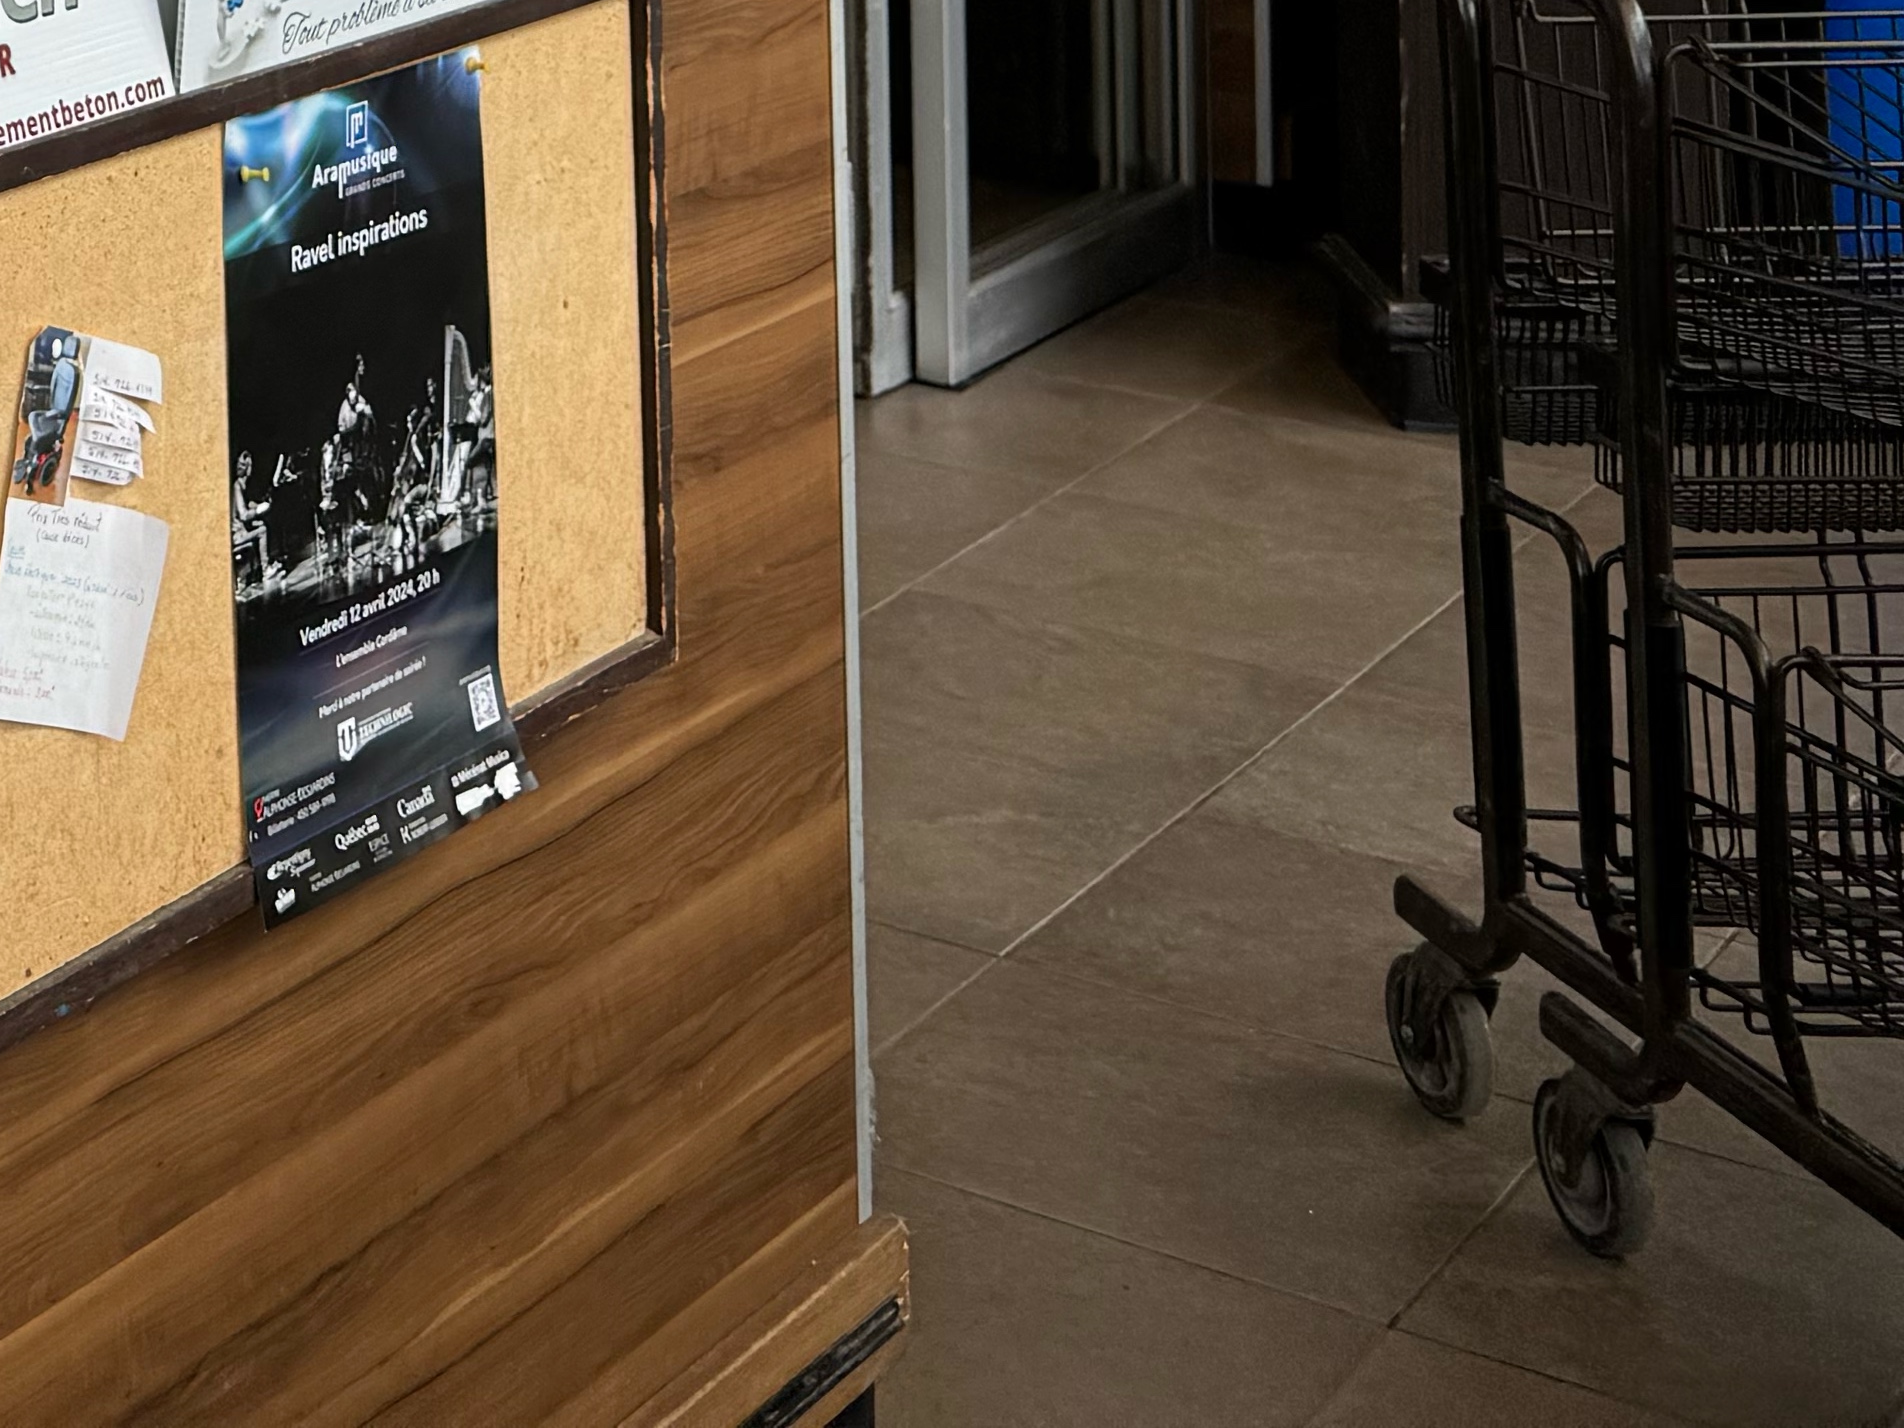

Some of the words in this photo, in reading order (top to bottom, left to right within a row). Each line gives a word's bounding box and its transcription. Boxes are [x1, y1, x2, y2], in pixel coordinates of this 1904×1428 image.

[282, 12, 325, 55] Tout
[312, 144, 398, 200] Aramusique
[292, 242, 334, 272] Ravel
[337, 207, 428, 257] inspirations
[300, 609, 348, 646] Vendredi
[349, 603, 360, 621] 12
[361, 592, 386, 619] avril
[387, 579, 416, 610] 2024,
[418, 574, 430, 592] 20
[397, 785, 435, 818] Canada
[335, 818, 368, 850] Québec
